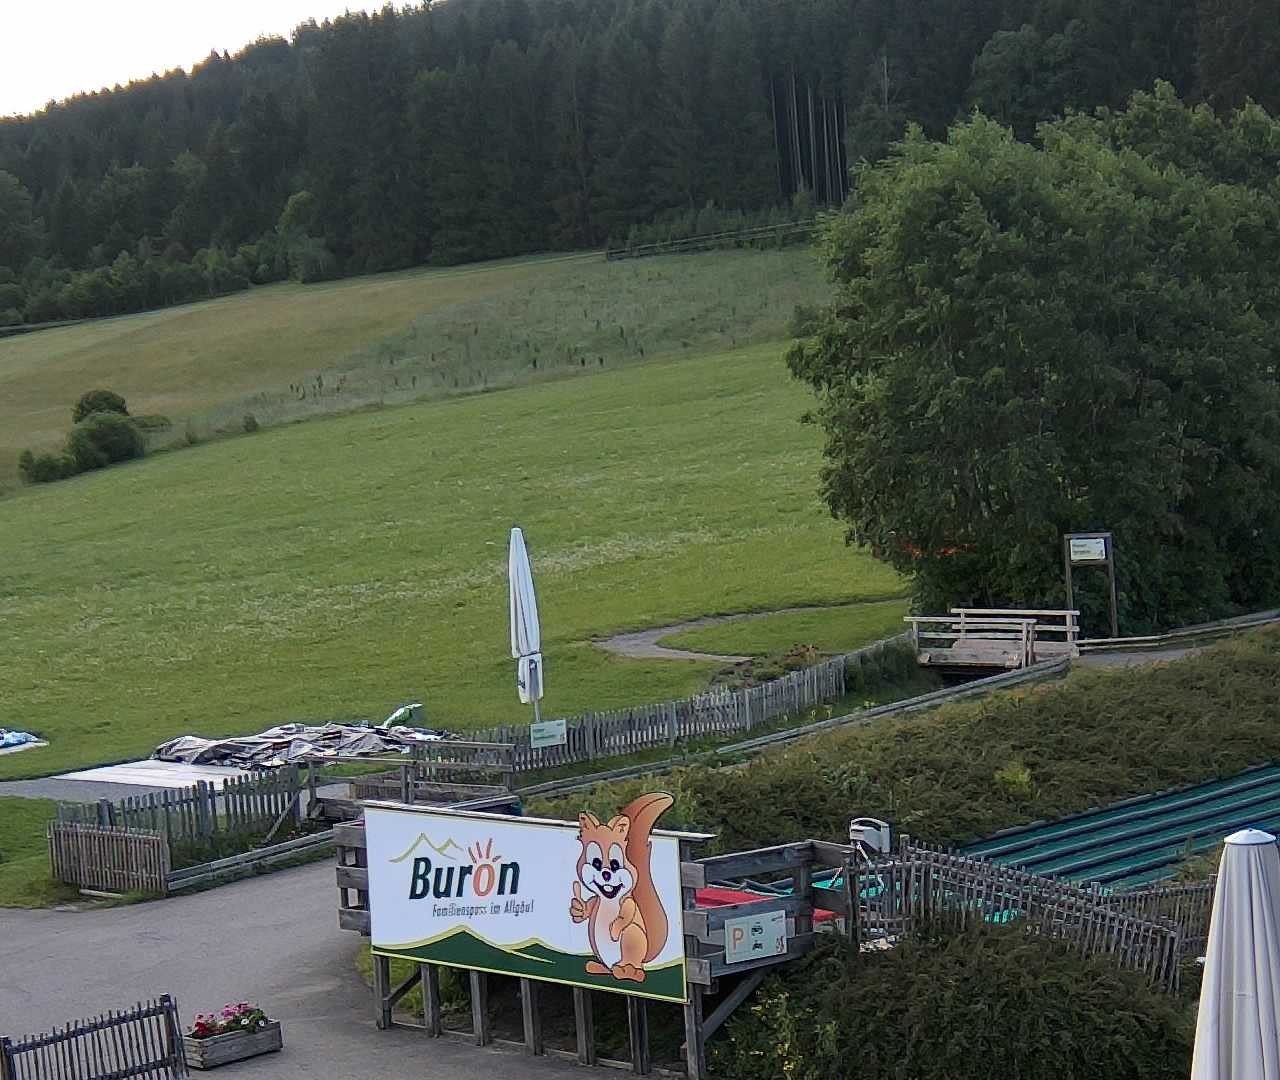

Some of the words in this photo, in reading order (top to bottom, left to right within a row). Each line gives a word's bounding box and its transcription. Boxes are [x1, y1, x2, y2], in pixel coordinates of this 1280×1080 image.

[409, 856, 521, 900] Buron
[490, 901, 501, 914] im
[732, 927, 744, 952] P
